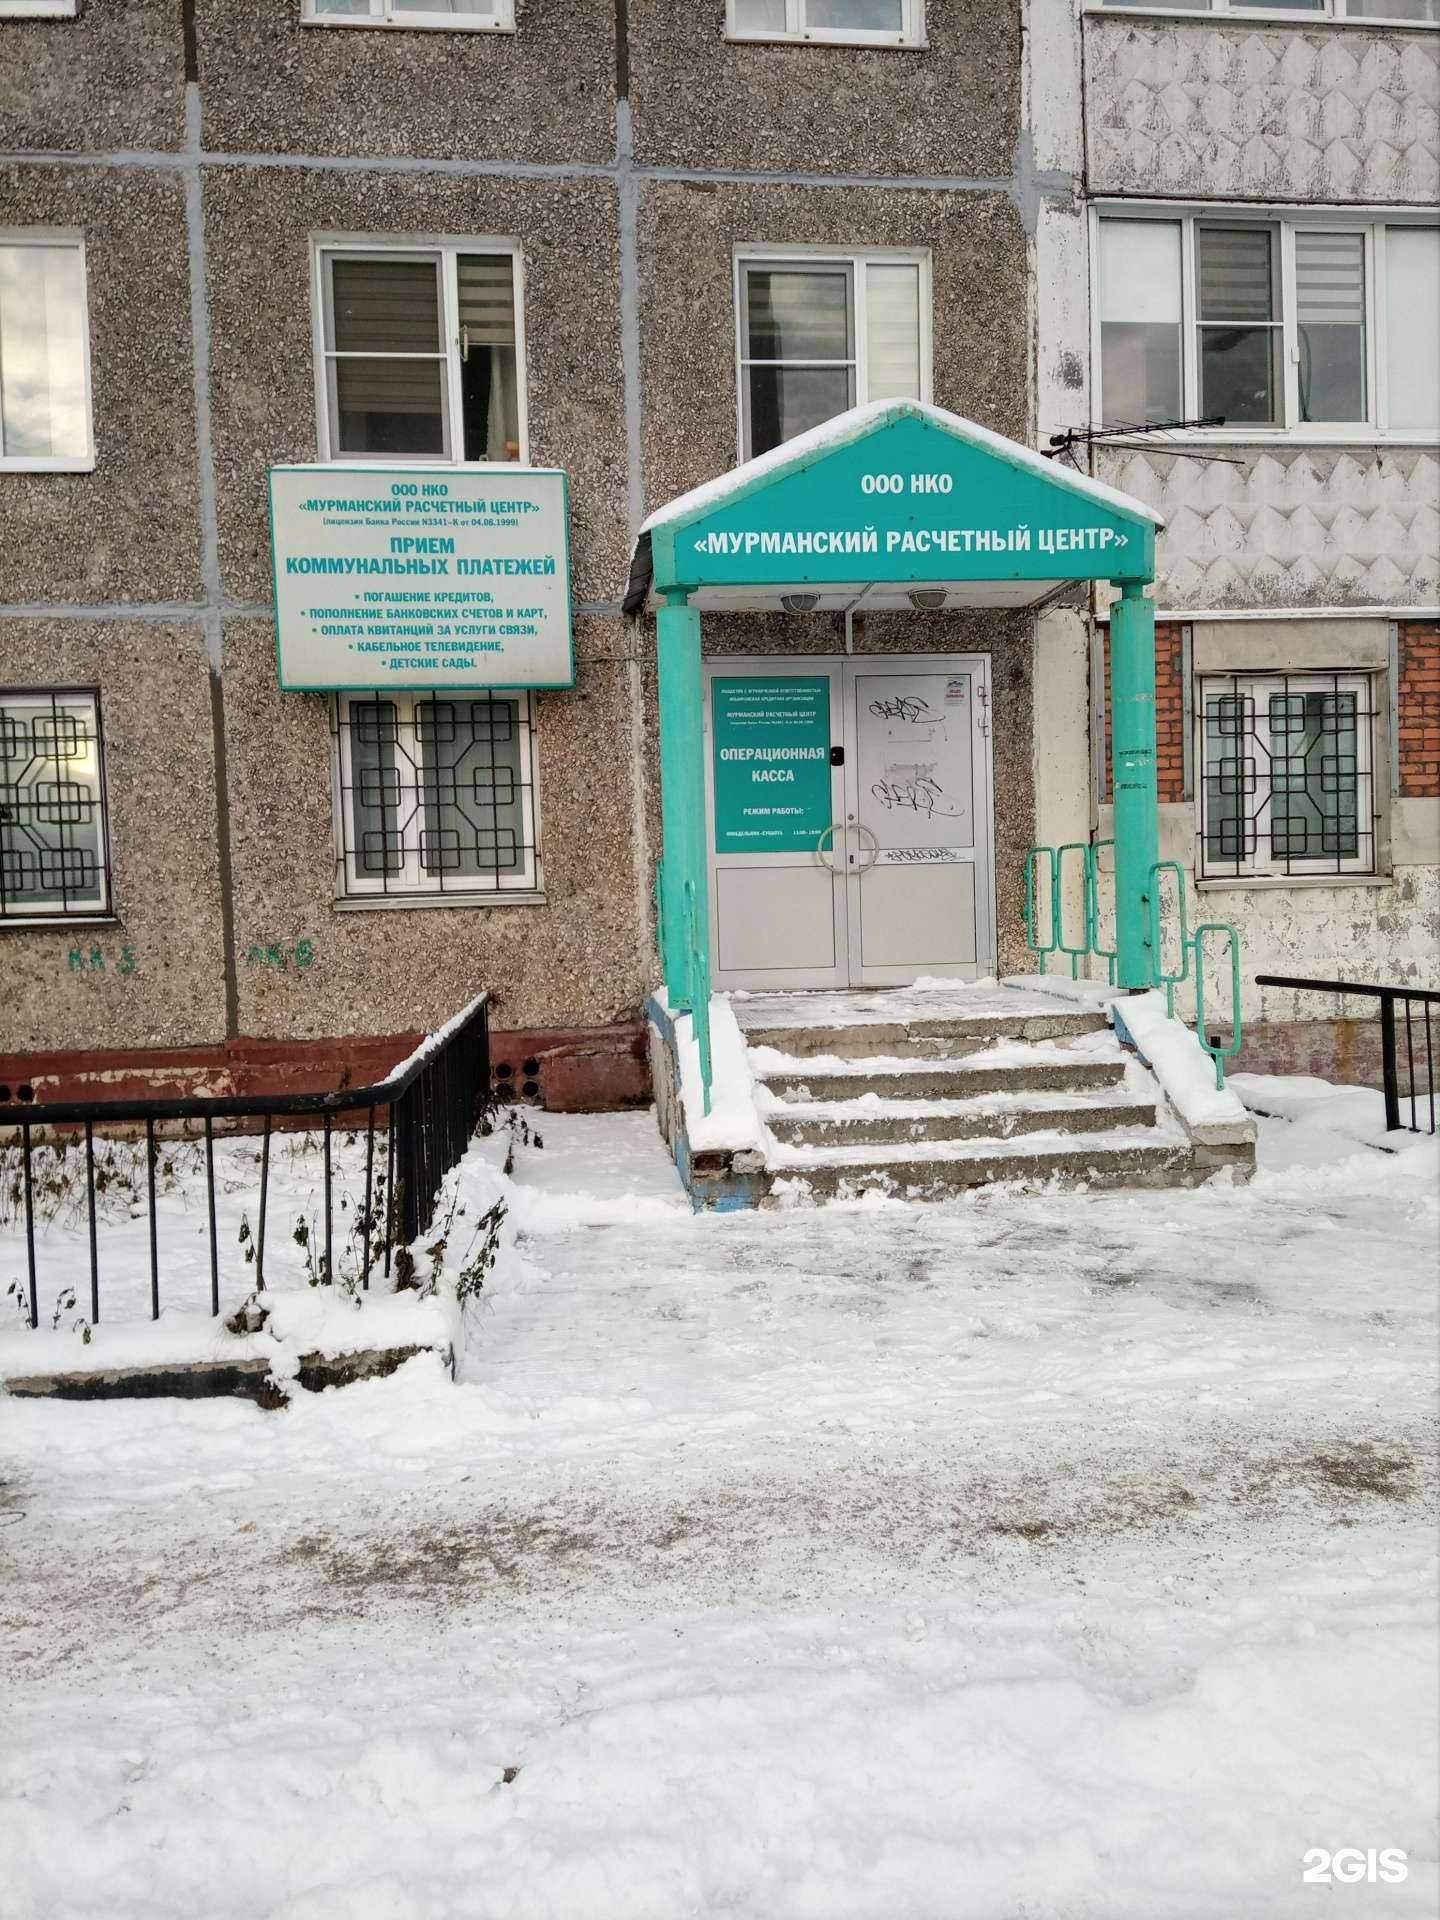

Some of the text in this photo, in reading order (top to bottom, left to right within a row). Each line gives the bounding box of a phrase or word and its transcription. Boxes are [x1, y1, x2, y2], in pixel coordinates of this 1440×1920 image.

[391, 484, 448, 496] ООО НКО
[861, 474, 953, 494] ООО НКО
[299, 498, 540, 515] «МУРМАНСКИЙ РАСЧЕТНЫЙ ЦЕНТР»
[391, 518, 420, 526] России
[390, 537, 455, 553] ПРИЕМ
[693, 524, 1129, 554] «МУРМАНСКИЙ РАСЧЕТНЫЙ ЦЕНТР»
[286, 554, 556, 576] КОММУНАЛЬНЫХ ПЛАТЕЖЕЙ
[363, 592, 494, 603] ПОГАШЕНИЕ КРЕДИТОВ,
[309, 608, 548, 619] ПОПОЛНЕНИЕ БАНКОВСКИХ СЧЕТОВ И КАРТ,
[321, 623, 538, 636] ОПЛАТА КВИТАНЦИЙ ЗА УСЛУГИ СВЯЗИ,
[357, 641, 505, 653] КАБЕЛЬНОЕ ТЕЛЕВИДЕНИЕ,
[390, 658, 478, 669] ДЕТСКИЕ САДЫ.
[720, 747, 825, 762] ОПЕРАЦИОННАЯ
[751, 770, 795, 782] КАССА
